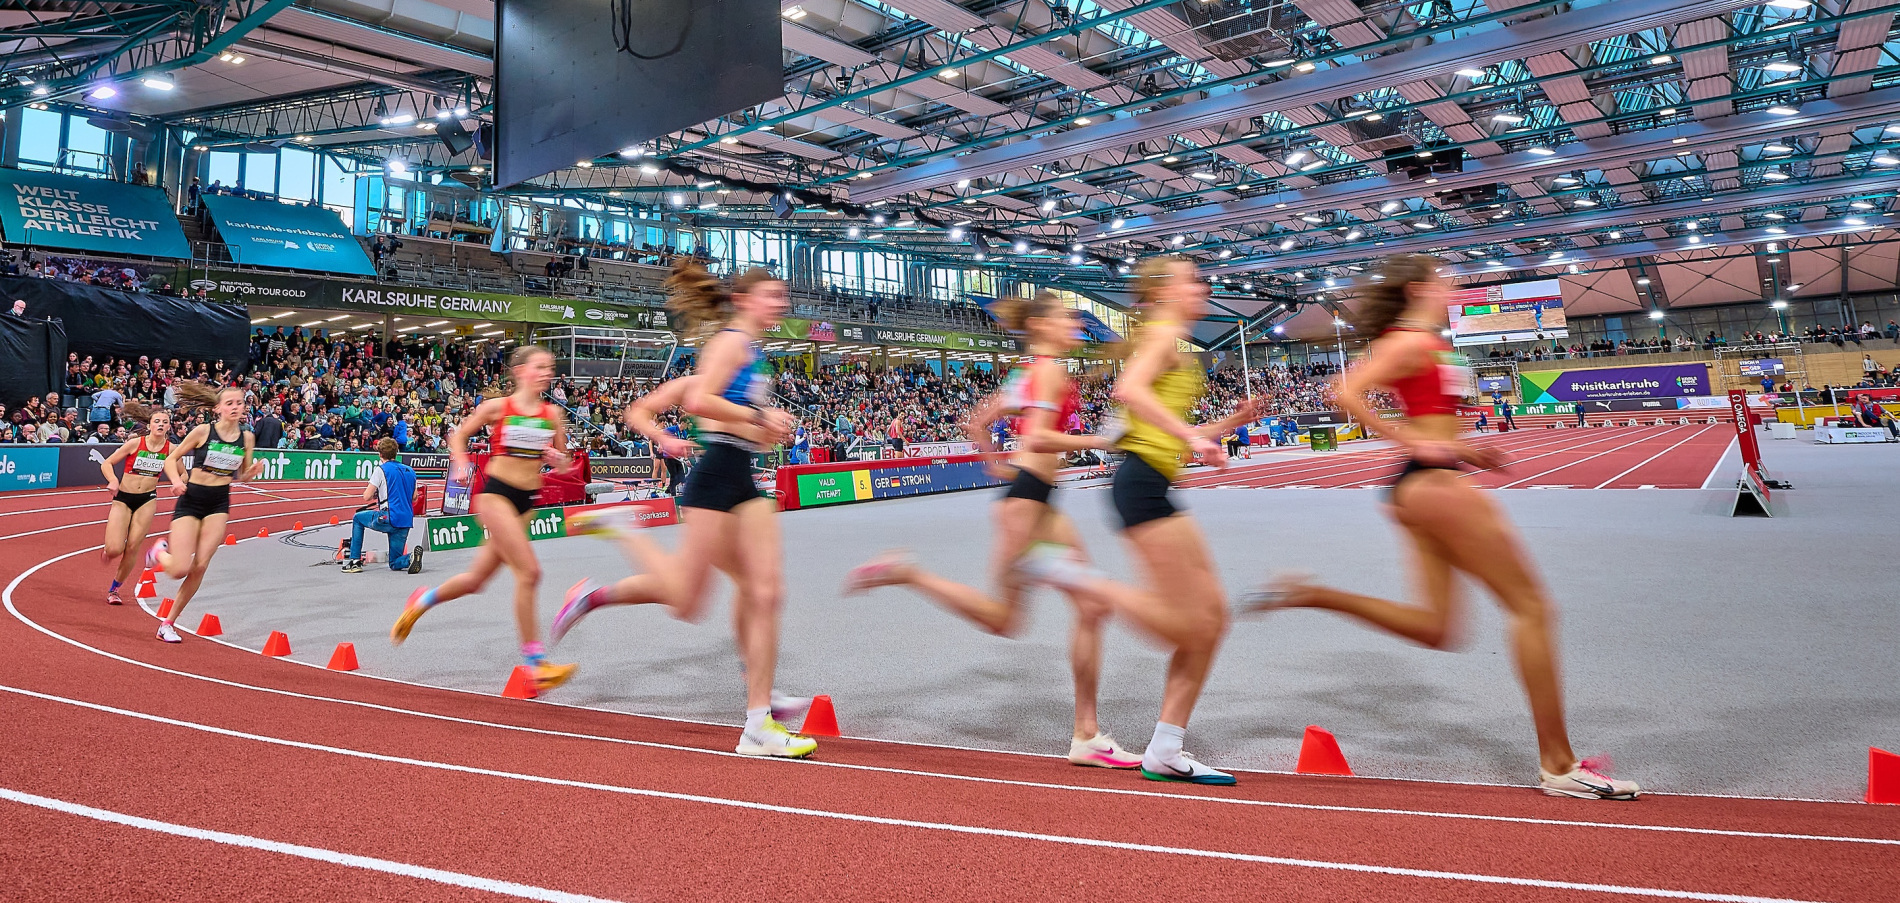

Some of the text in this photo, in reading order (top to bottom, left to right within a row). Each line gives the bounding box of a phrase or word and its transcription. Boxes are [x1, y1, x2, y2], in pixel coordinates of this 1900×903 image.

[13, 183, 80, 200] WELT
[16, 195, 110, 215] KLASSE
[20, 206, 160, 230] DER LEICHT
[23, 219, 143, 240] ATHLETIK
[226, 220, 345, 239] karlsruhe-erleben.de
[220, 284, 306, 298] INDOOR TOUR GOLD
[342, 288, 512, 314] KARLSRUHE GERMANY
[877, 330, 916, 342] KARLSRUHE
[916, 334, 946, 344] GERMANY
[1570, 378, 1660, 392] #visitkarlsruhe
[1526, 404, 1547, 414] init
[1554, 402, 1577, 413] init
[1734, 403, 1748, 434] OMEGA
[252, 452, 291, 480] init
[304, 453, 342, 480] init
[610, 466, 629, 474] TOUR
[630, 465, 651, 474] GOLD
[818, 478, 836, 486] VALID
[860, 480, 867, 490] 5.
[875, 474, 931, 489] GER STROH N
[816, 489, 841, 499] ATTEMPT
[638, 510, 670, 521] Sparkasse
[530, 512, 562, 536] init
[432, 521, 470, 546] init
